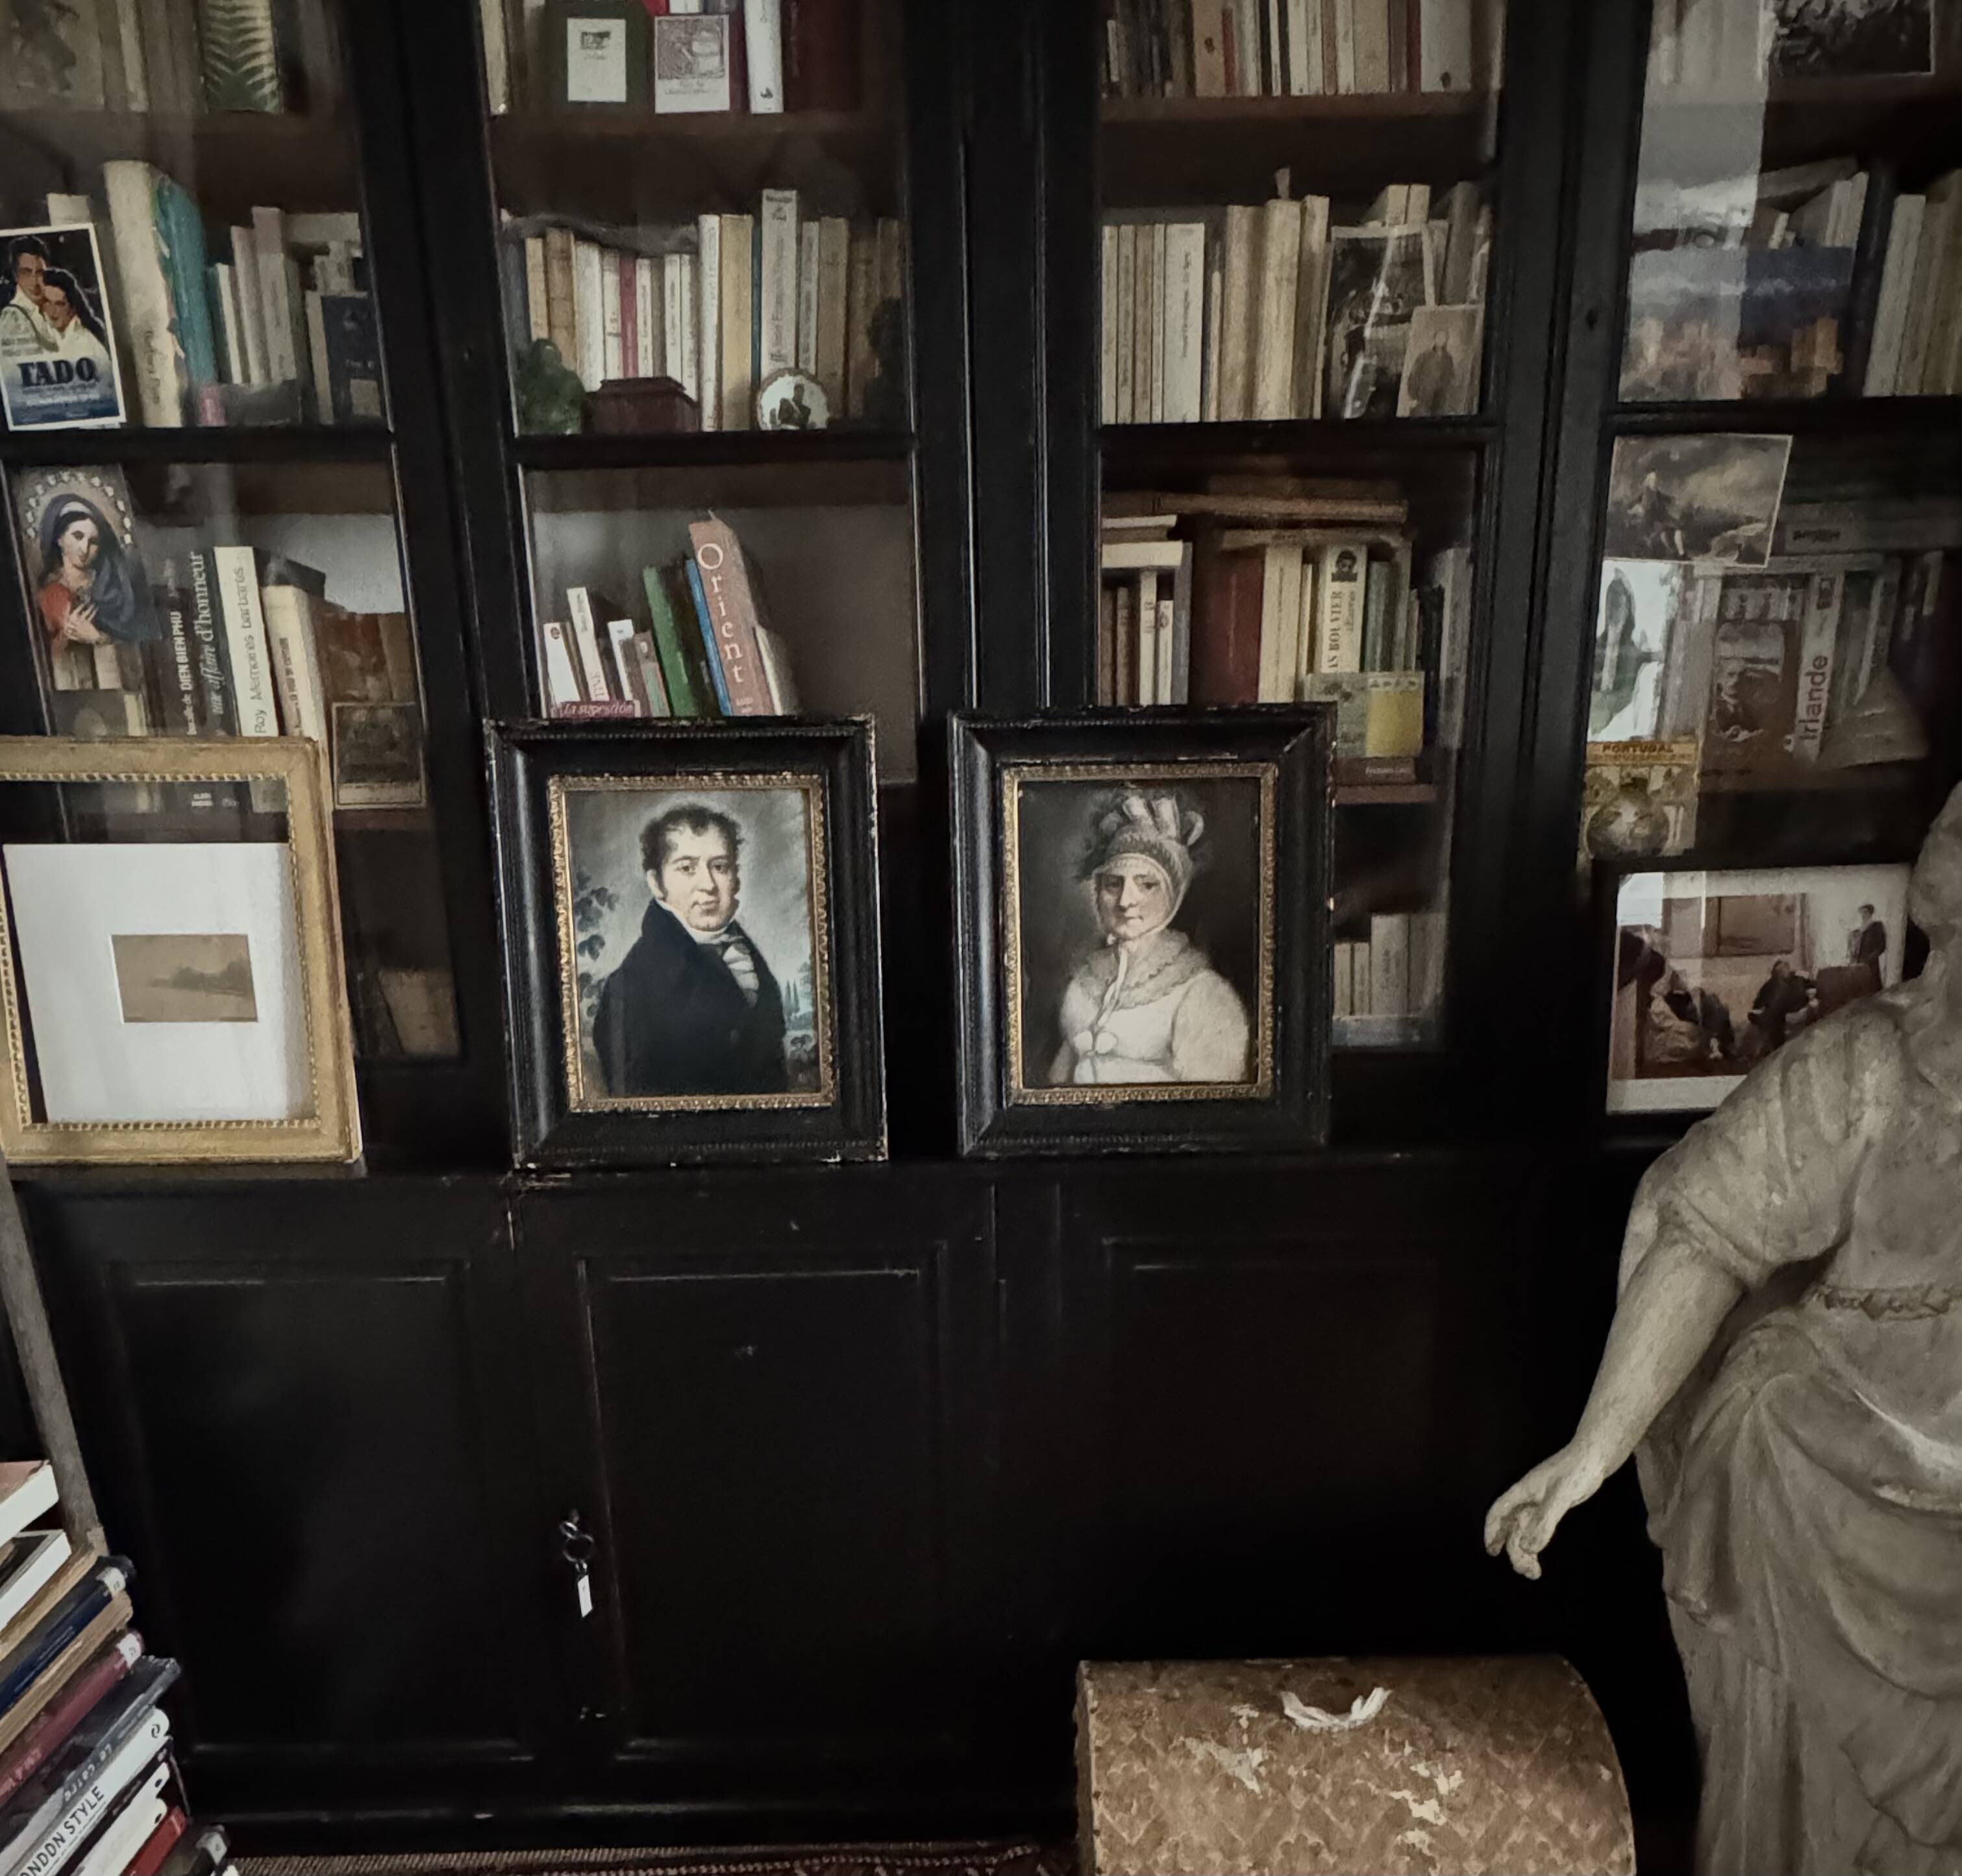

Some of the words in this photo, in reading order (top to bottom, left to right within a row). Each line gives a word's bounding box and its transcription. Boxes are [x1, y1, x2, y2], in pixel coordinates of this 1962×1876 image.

[190, 552, 214, 642] d'honneur
[697, 543, 744, 683] Orient
[170, 611, 185, 637] PHU
[1328, 592, 1342, 651] BOUVIER
[173, 638, 189, 664] BIEN
[177, 664, 193, 691] DIEN
[1798, 655, 1829, 740] Irlande
[255, 709, 267, 733] Roy
[1602, 742, 1674, 753] PORTUGAL
[64, 1786, 105, 1835] STYLE
